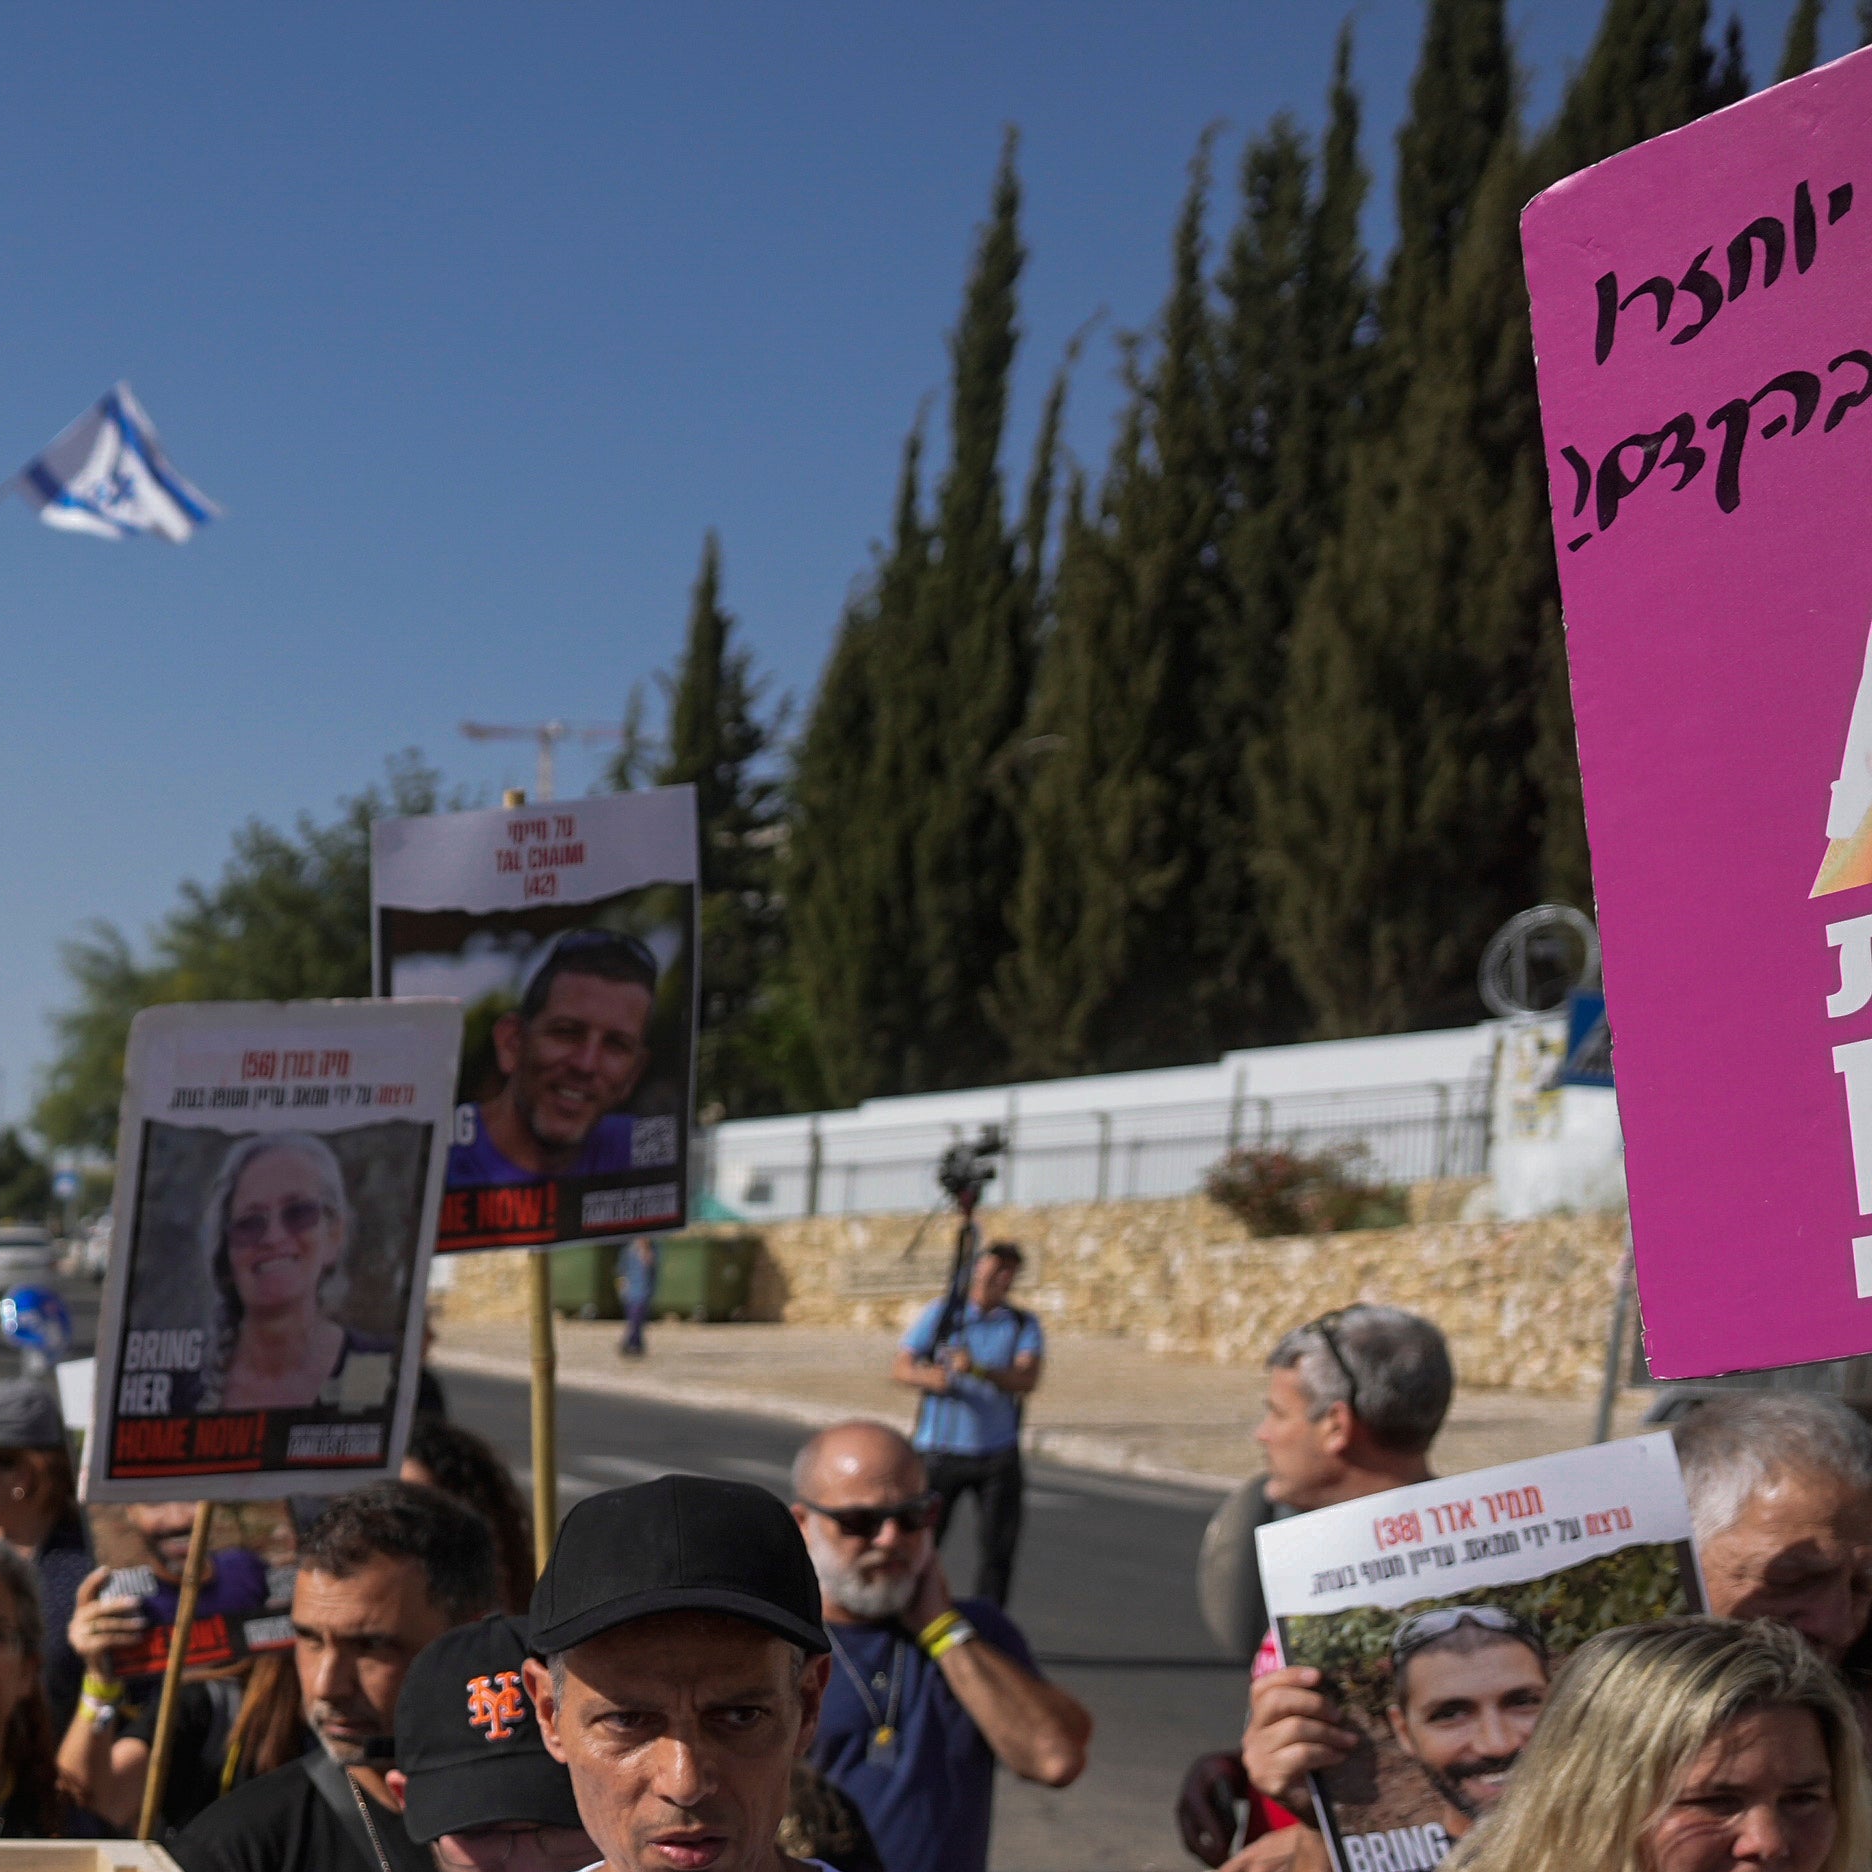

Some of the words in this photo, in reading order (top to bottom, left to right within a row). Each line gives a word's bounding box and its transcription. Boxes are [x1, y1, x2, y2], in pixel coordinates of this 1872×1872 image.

[496, 849, 522, 873] TAL
[477, 1181, 557, 1230] NOW!
[124, 1329, 204, 1372] BRING
[118, 1372, 172, 1417] HER
[1426, 1498, 1478, 1536] אדר
[1480, 1485, 1547, 1525] תמיר
[1373, 1508, 1424, 1550] (38)
